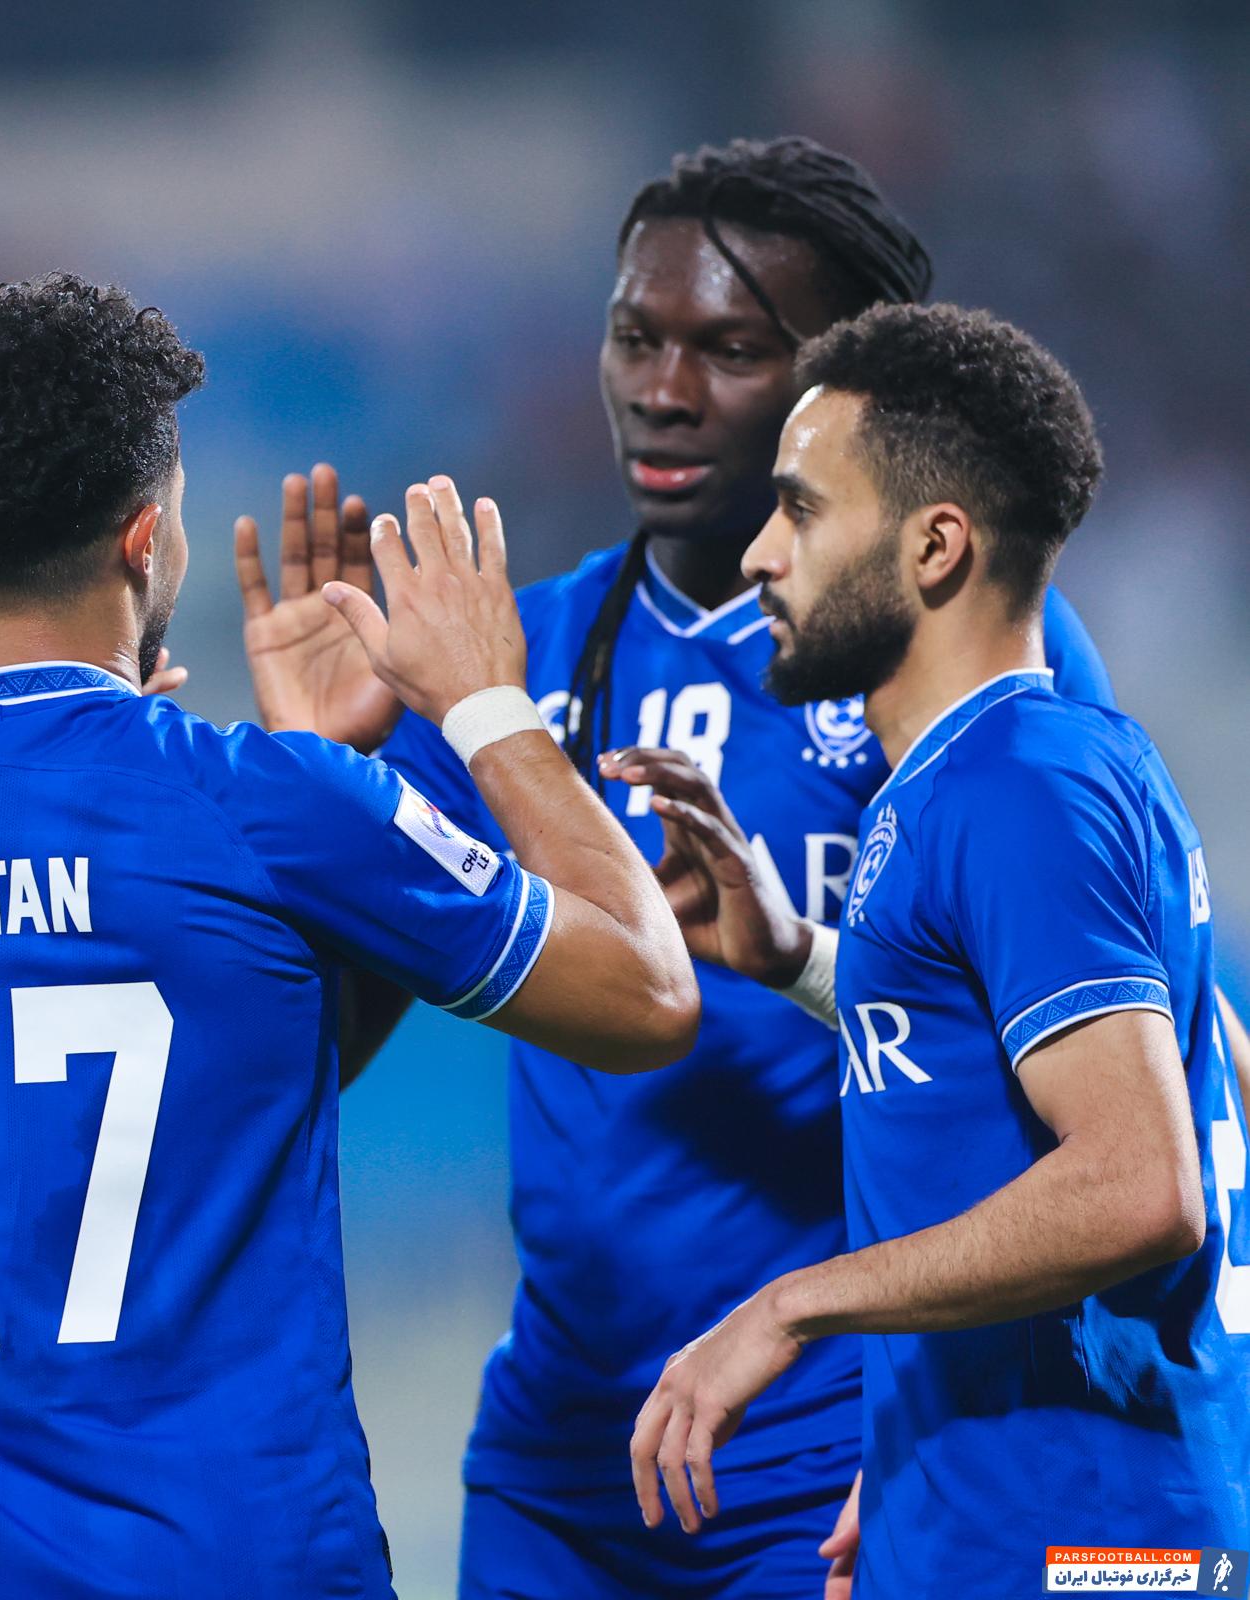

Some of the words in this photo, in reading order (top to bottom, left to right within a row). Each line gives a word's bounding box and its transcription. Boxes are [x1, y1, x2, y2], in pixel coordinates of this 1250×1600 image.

[461, 847, 479, 873] CHA
[477, 853, 490, 870] LE
[836, 1001, 934, 1098] AR
